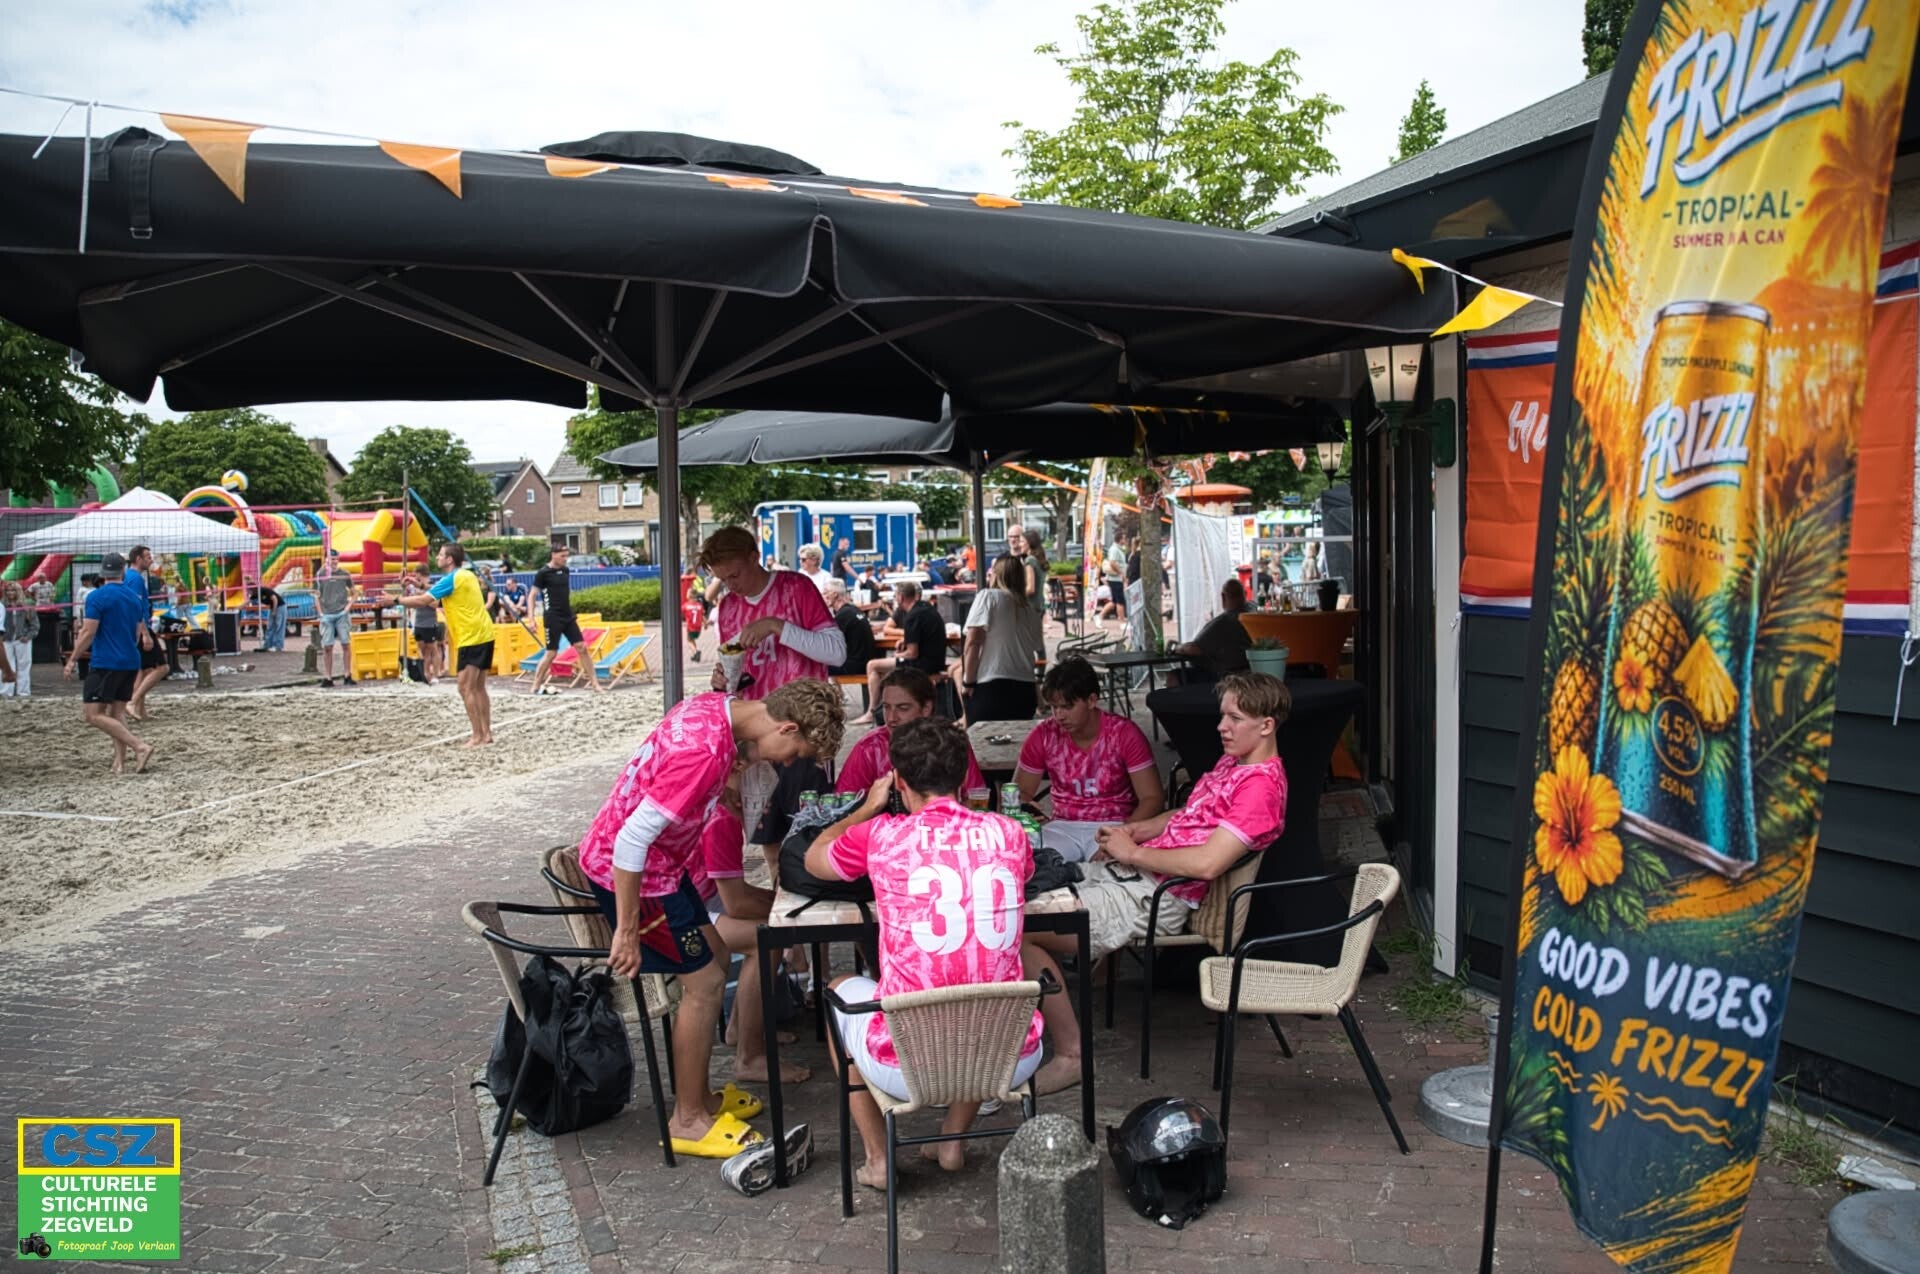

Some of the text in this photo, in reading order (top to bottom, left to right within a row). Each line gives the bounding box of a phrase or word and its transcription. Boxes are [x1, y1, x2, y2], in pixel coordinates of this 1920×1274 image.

[1754, 229, 1785, 245] CAN
[1508, 400, 1549, 464] Hu
[692, 610, 698, 624] 7
[751, 633, 777, 667] 24
[918, 824, 1006, 852] TEJAN
[907, 862, 1019, 956] 30
[1538, 927, 1773, 1039] GOOD VIBES
[1532, 985, 1603, 1054] COLD
